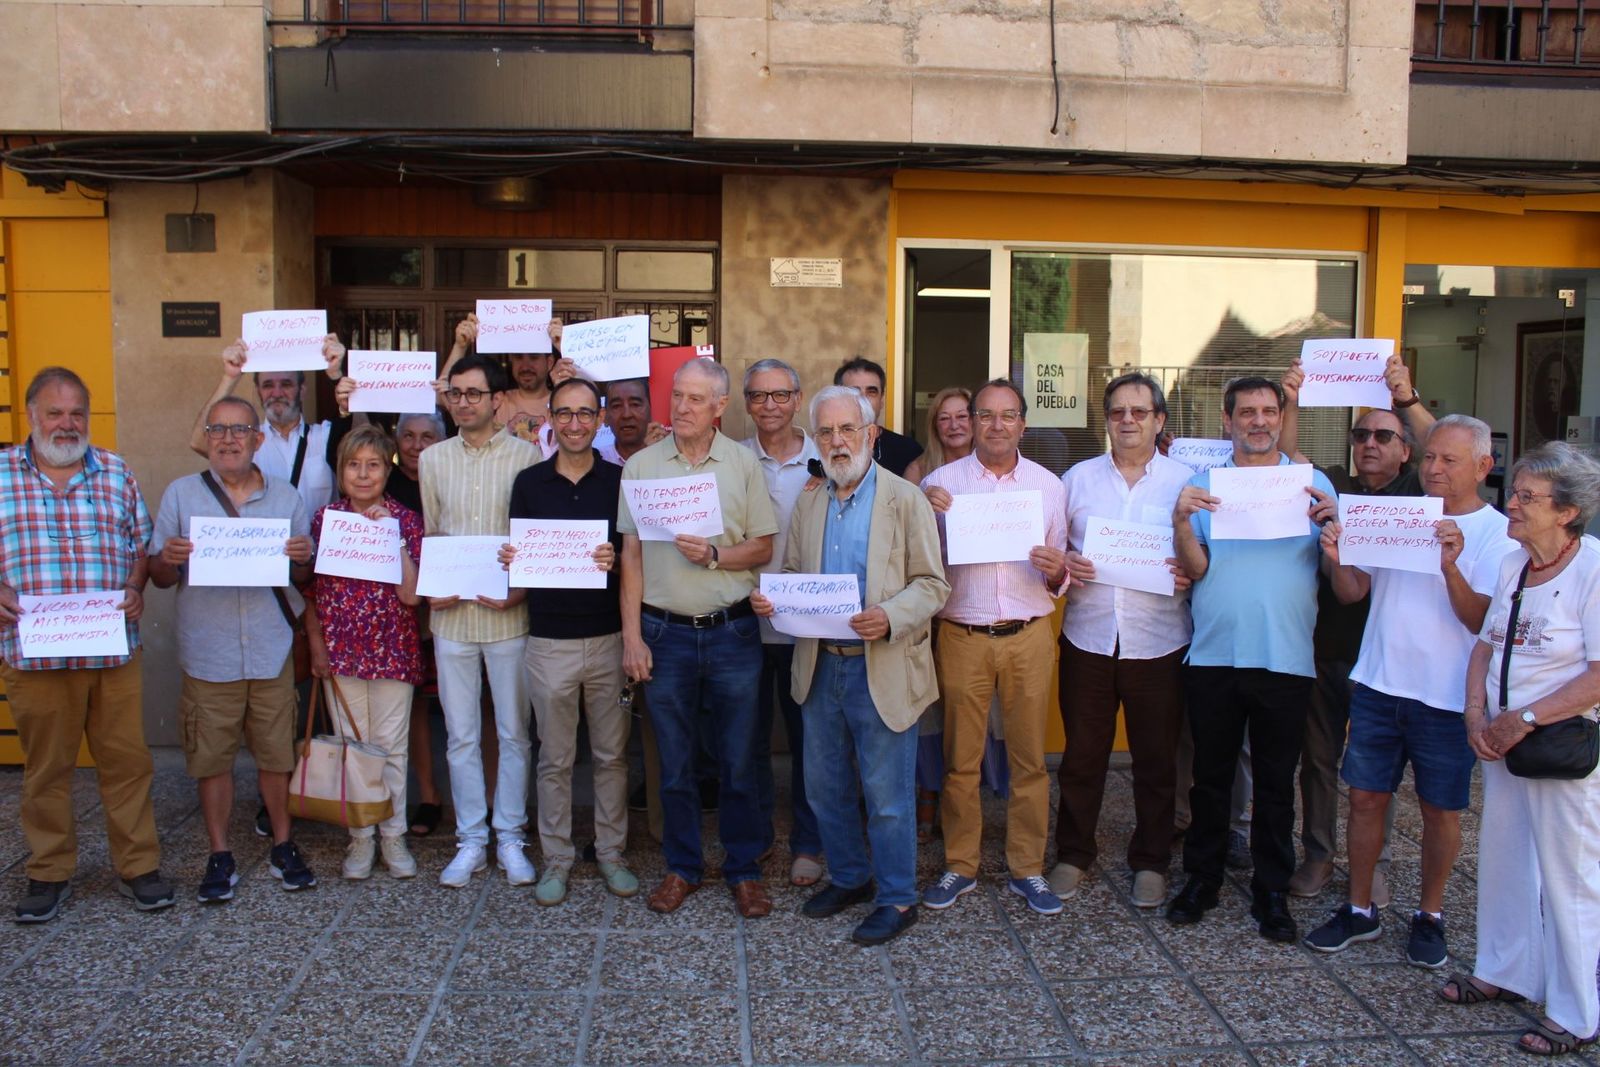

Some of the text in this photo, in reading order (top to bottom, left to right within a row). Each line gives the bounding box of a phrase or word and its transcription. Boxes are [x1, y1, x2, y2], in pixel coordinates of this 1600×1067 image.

[515, 253, 528, 286] 1
[484, 304, 547, 316] YO NO ROBO
[278, 316, 320, 330] MIENTO
[1312, 350, 1380, 363] SOY POETA
[1037, 363, 1064, 378] CASA
[1036, 379, 1056, 393] DEL
[1036, 395, 1077, 409] PUEBLO
[634, 482, 715, 500] NO TENGO MIEDO
[637, 497, 700, 511] A DEBATIR
[331, 519, 385, 536] TRABAJO
[525, 529, 549, 540] SOY
[82, 599, 114, 610] POR
[32, 616, 60, 629] MIS
